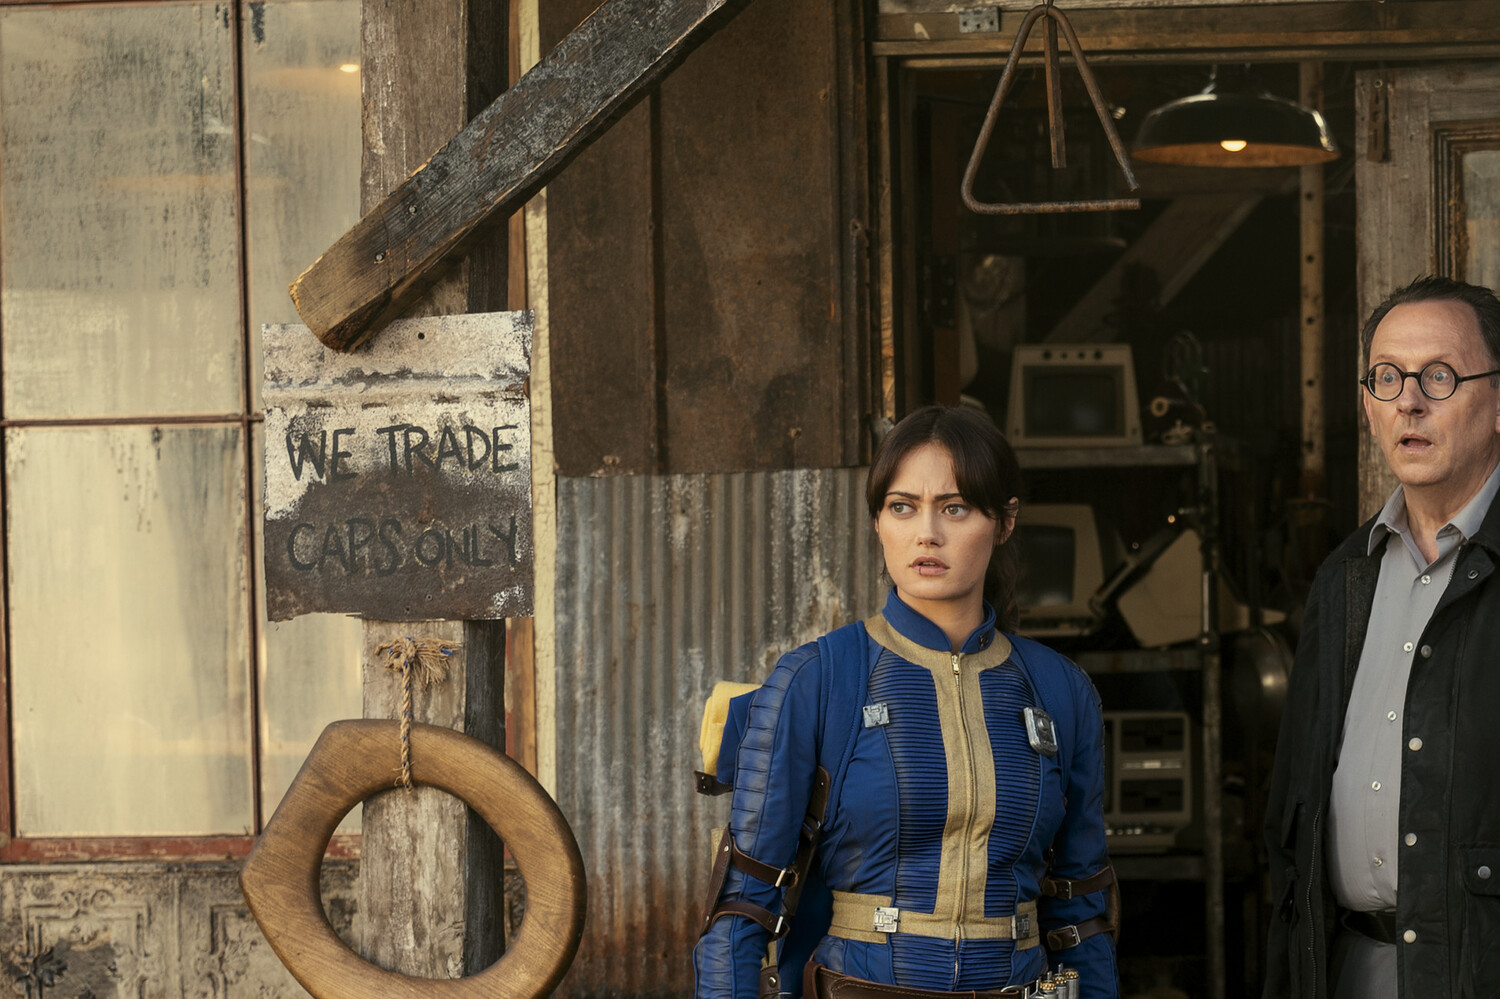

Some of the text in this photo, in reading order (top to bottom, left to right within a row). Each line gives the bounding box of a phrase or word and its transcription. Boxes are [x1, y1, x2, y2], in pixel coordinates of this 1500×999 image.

[285, 424, 519, 482] WE TRADE
[287, 514, 518, 577] CAPS ONLY
